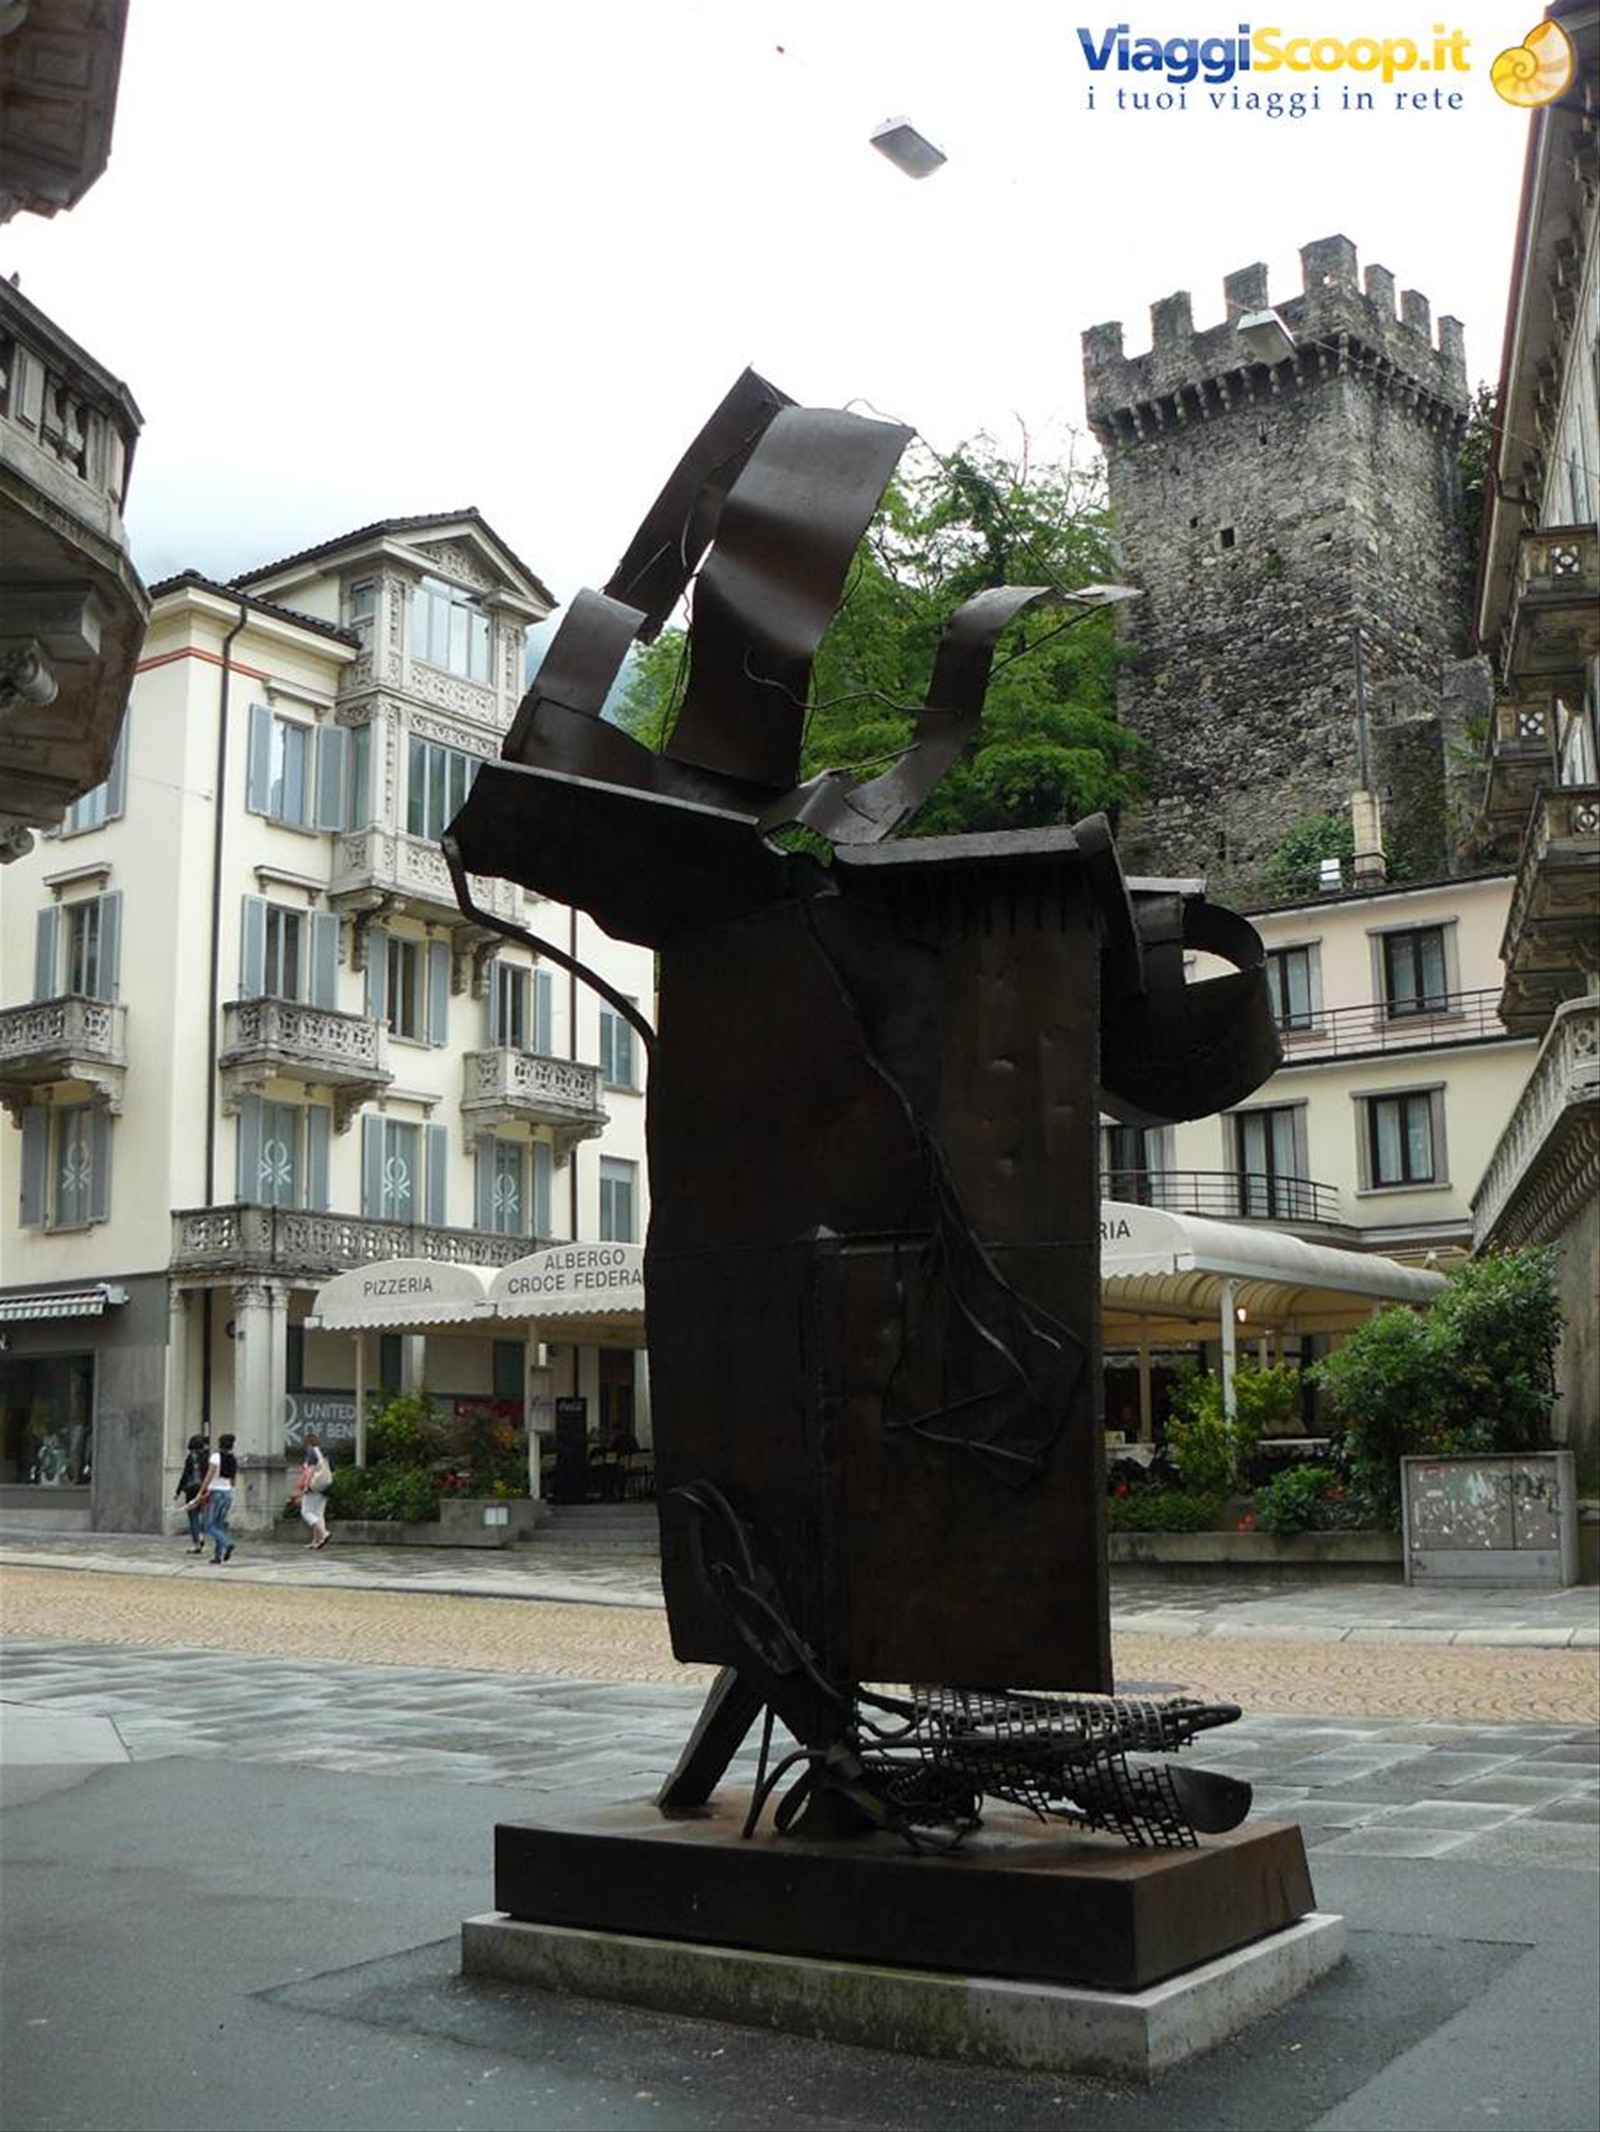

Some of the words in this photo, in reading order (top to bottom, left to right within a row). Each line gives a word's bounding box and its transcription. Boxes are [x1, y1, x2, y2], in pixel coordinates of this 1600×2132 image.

[544, 1249, 625, 1271] ALBERGO
[363, 1276, 433, 1297] PIZZERIA
[508, 1274, 566, 1294] CROCE
[304, 1403, 356, 1420] UNITED
